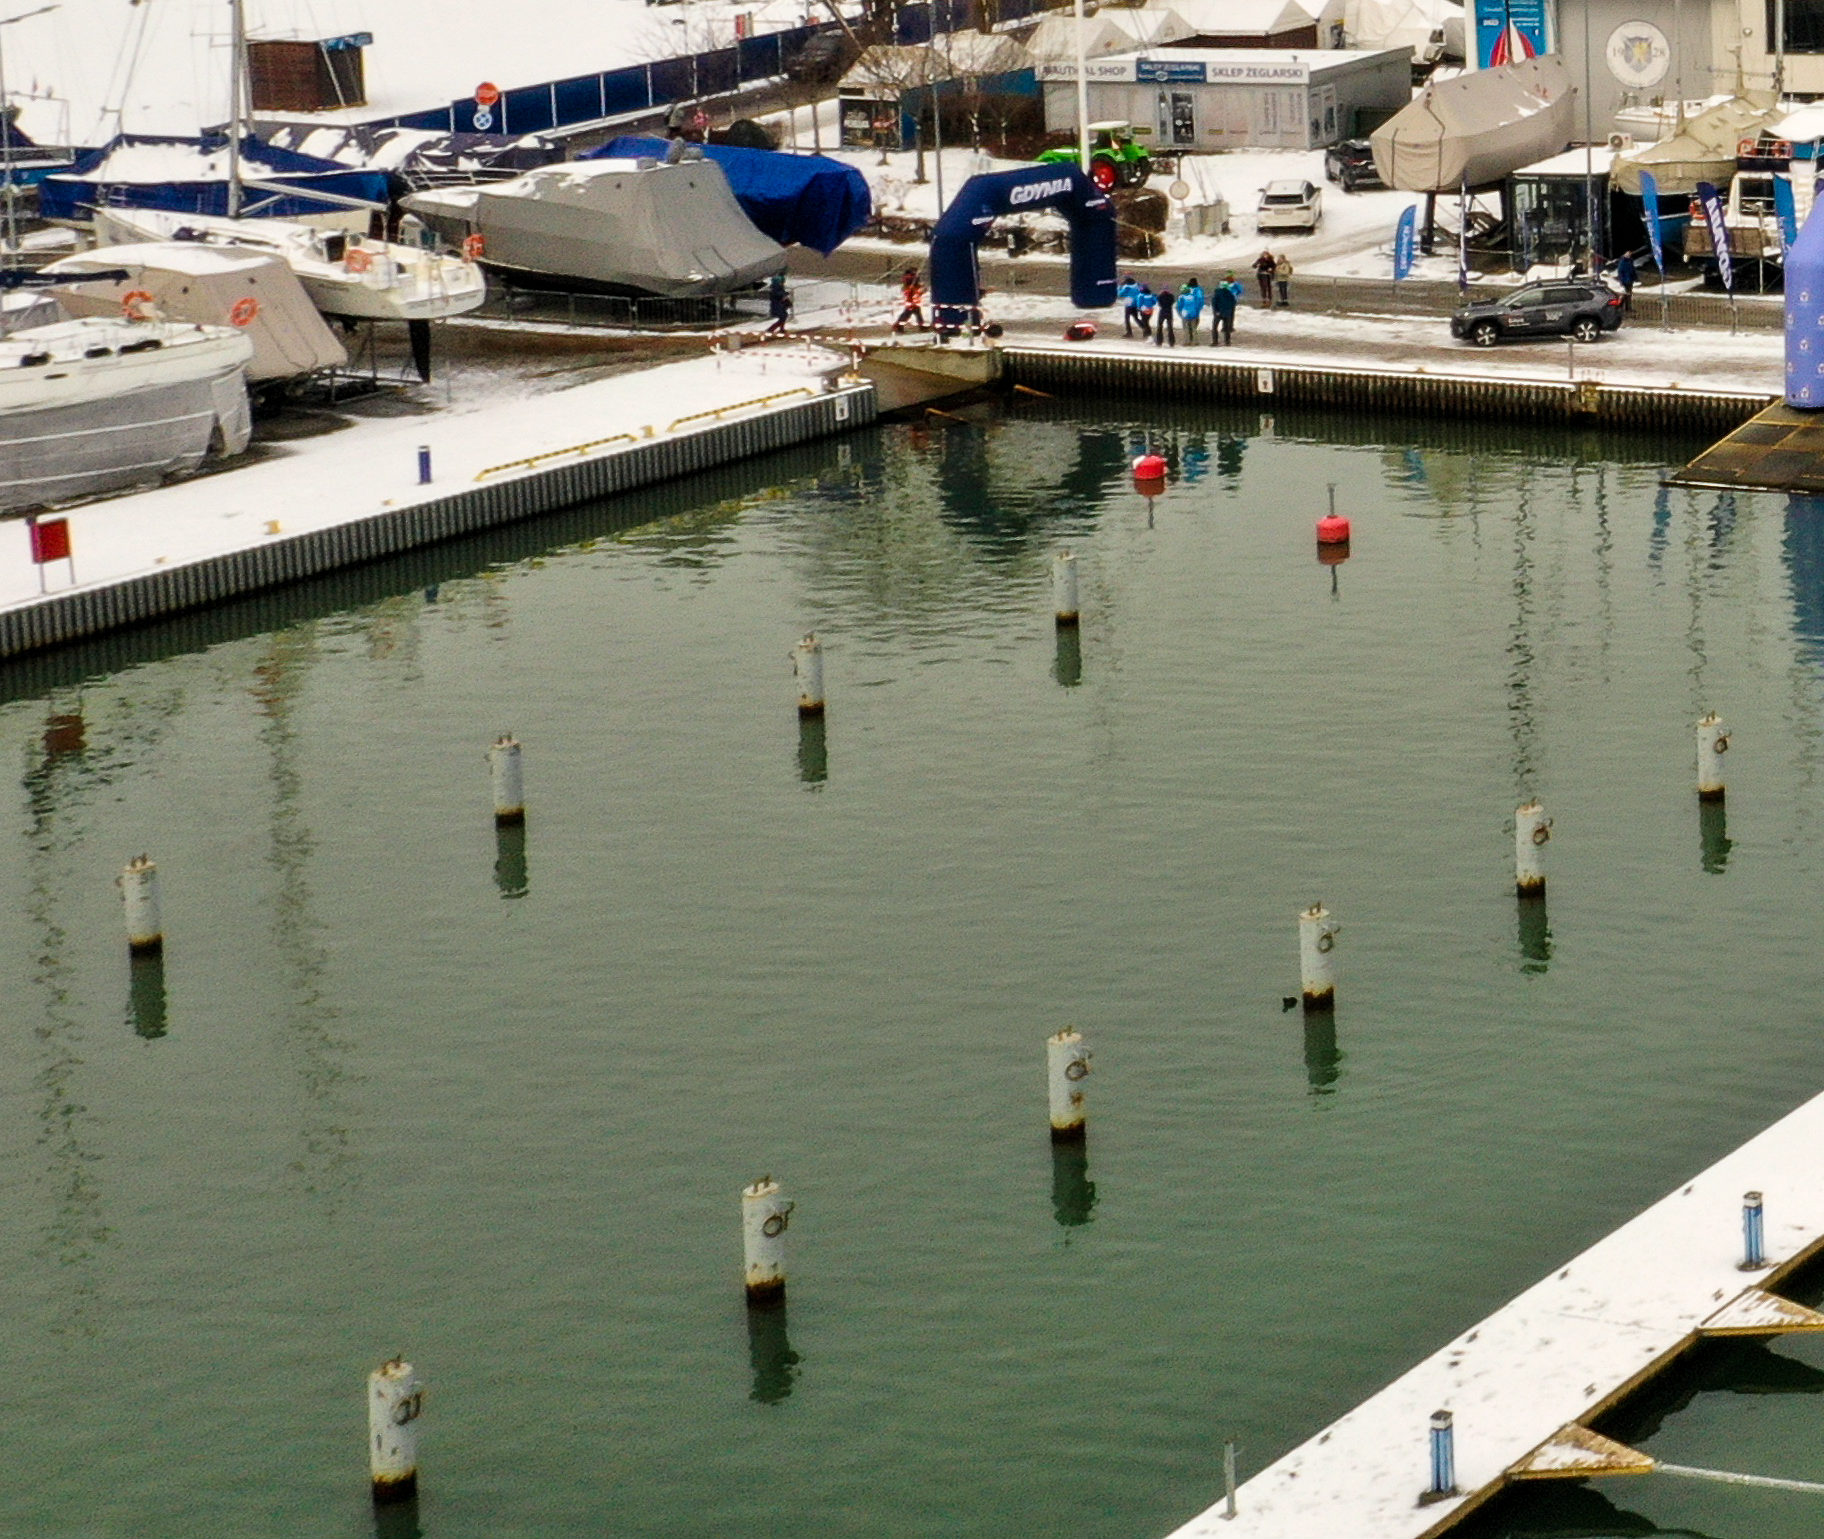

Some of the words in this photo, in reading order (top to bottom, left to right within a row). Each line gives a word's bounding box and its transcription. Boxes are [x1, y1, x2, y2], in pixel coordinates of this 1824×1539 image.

[1212, 67, 1244, 78] SKLEP
[1246, 65, 1303, 79] ŻEGLARSKI
[1010, 177, 1073, 205] GDYNIA
